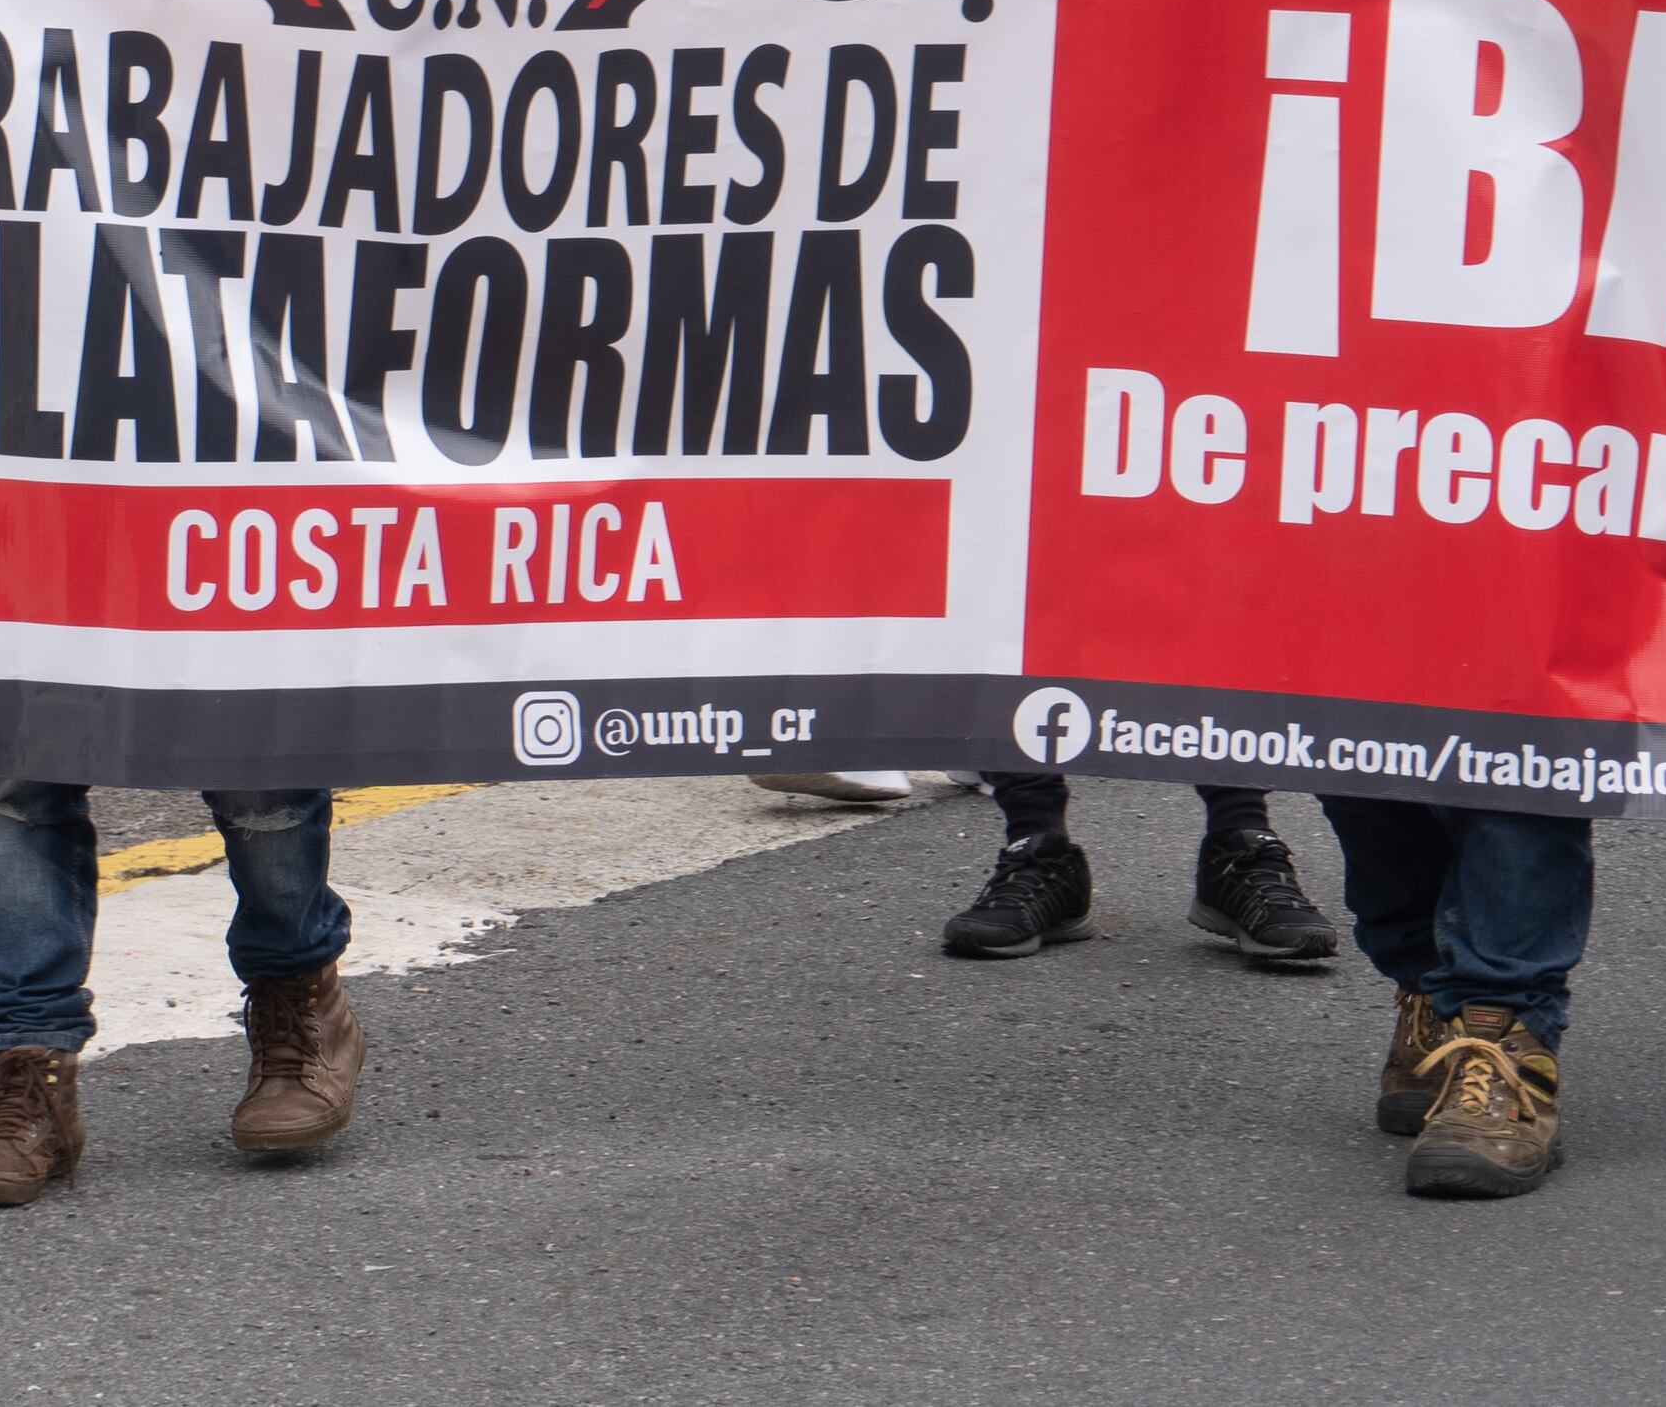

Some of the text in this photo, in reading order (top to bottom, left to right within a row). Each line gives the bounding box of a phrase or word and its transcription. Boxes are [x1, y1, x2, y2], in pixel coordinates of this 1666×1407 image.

[816, 43, 967, 221] DE
[1080, 367, 1246, 505] De
[166, 502, 683, 612] COSTA RICA
[594, 703, 816, 757] @untp_cr
